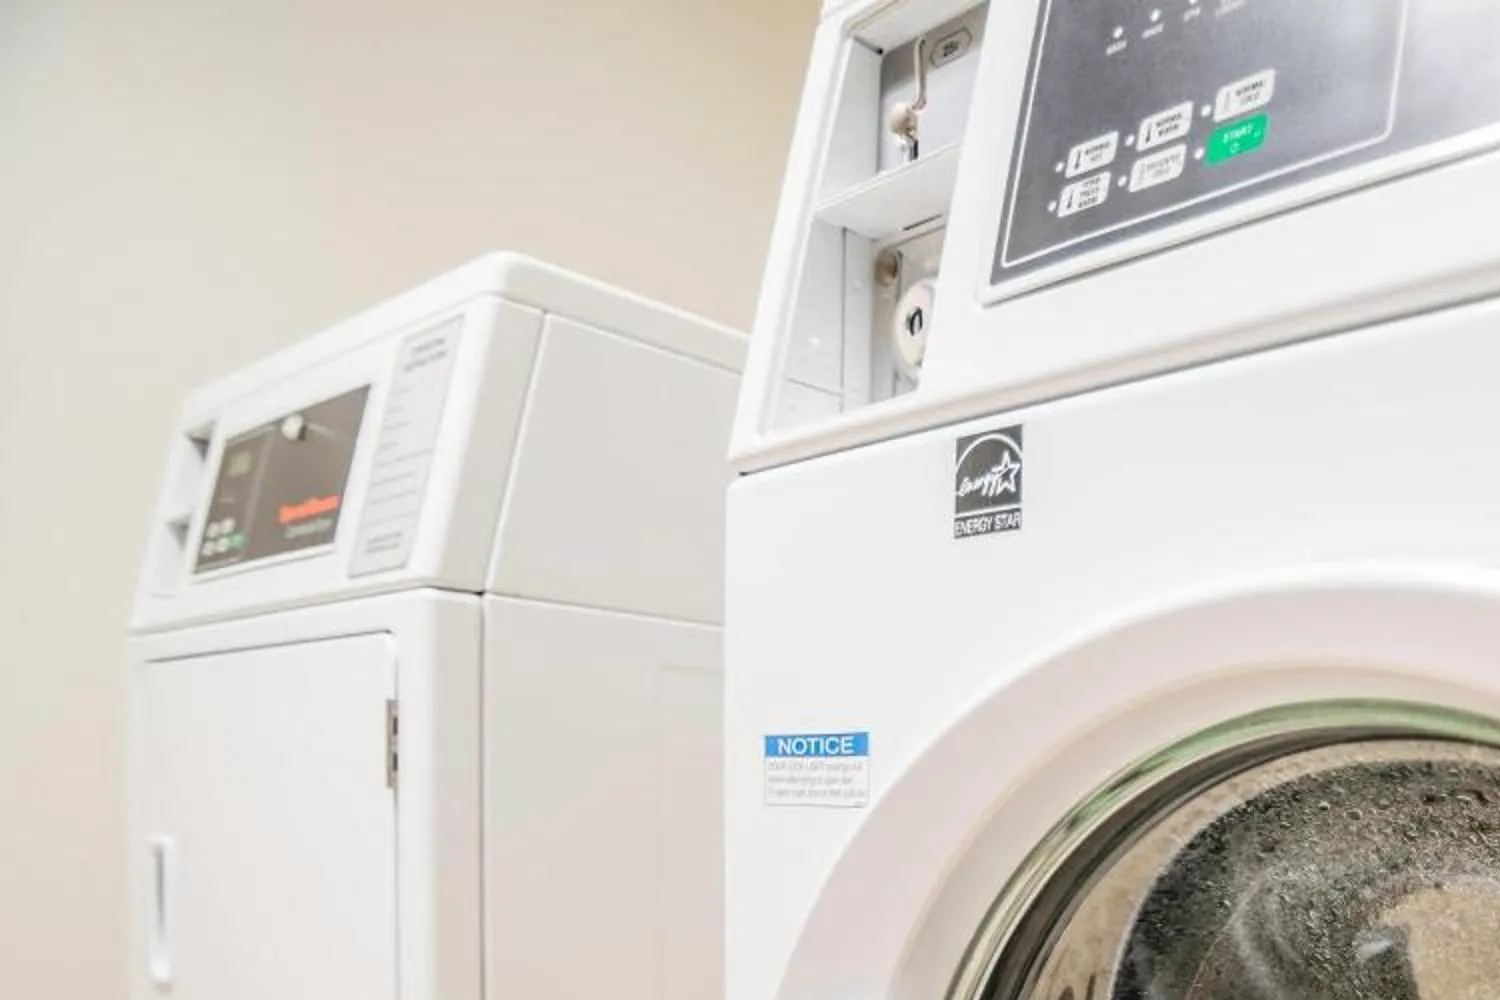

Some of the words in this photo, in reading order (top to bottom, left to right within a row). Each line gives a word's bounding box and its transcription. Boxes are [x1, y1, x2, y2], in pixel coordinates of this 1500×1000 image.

[955, 517, 993, 537] ENERGY
[995, 511, 1021, 530] STAR
[777, 735, 855, 755] NOTICE
